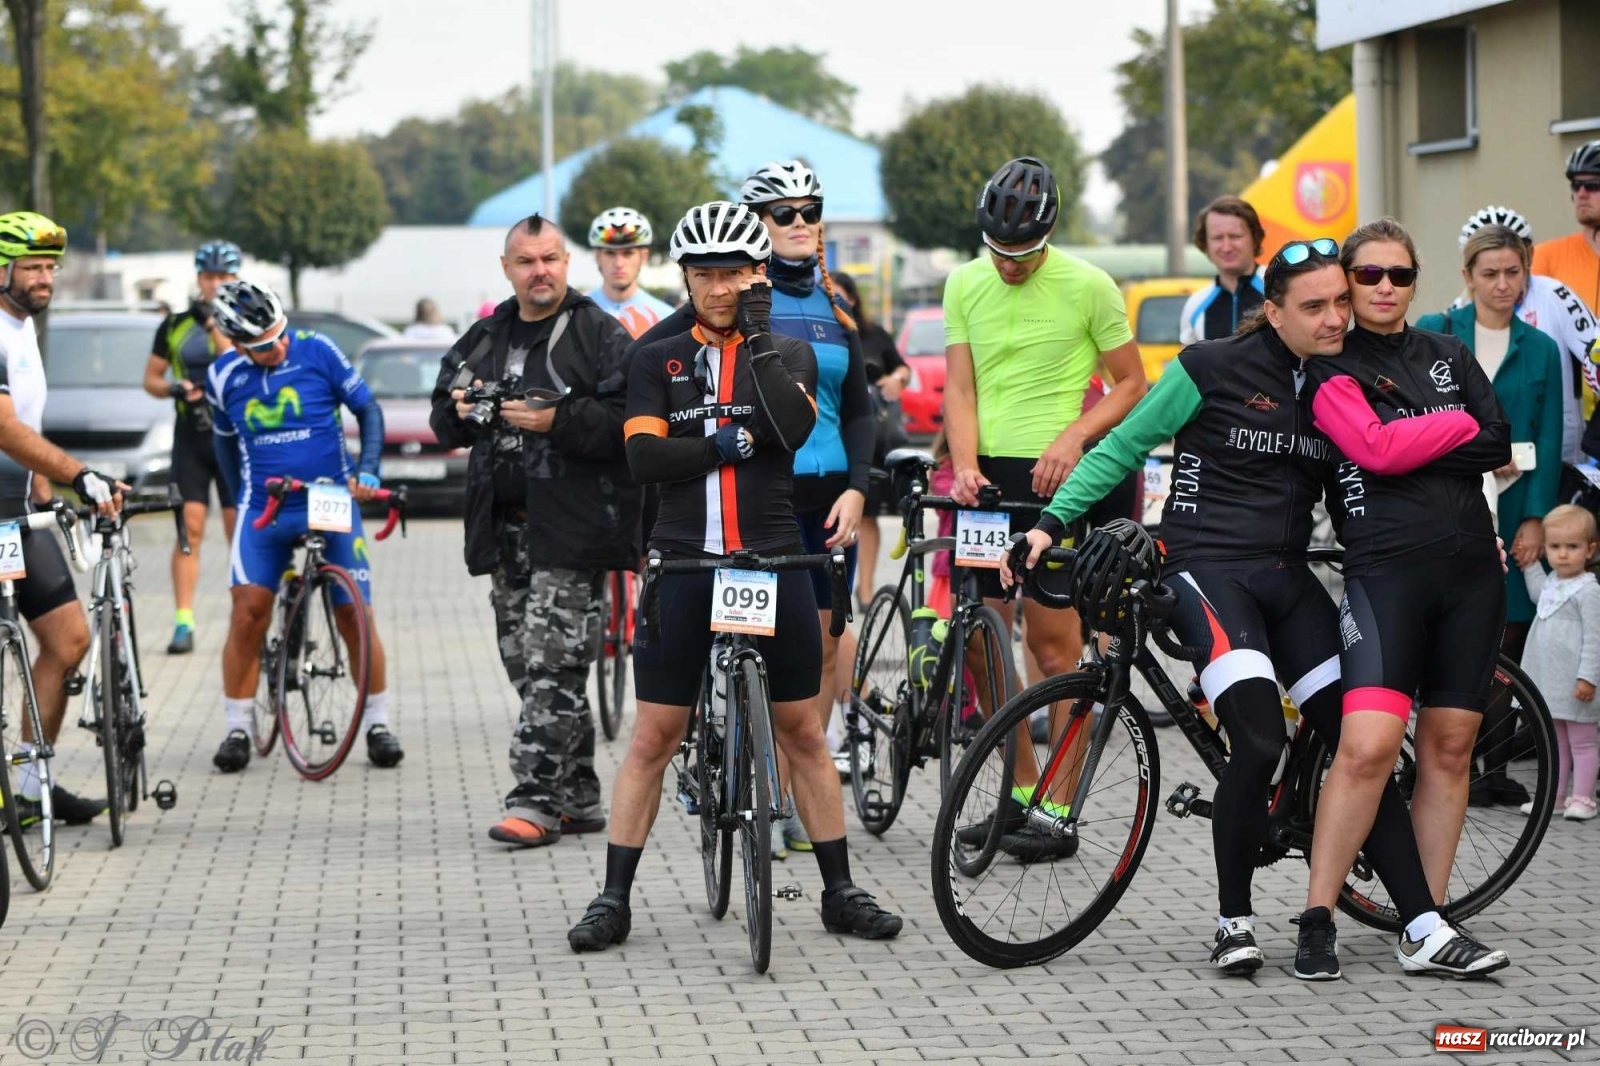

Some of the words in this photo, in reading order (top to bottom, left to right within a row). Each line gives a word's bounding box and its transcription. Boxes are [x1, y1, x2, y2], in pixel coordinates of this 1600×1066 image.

[1553, 286, 1589, 332] BTS
[670, 406, 715, 422] ZWIFT
[720, 405, 755, 416] Tea
[254, 429, 311, 446] movistar
[1226, 427, 1237, 448] Team
[1173, 452, 1202, 514] CYCLE
[314, 499, 349, 516] 2077
[961, 529, 1006, 547] 1143
[722, 586, 770, 610] 099
